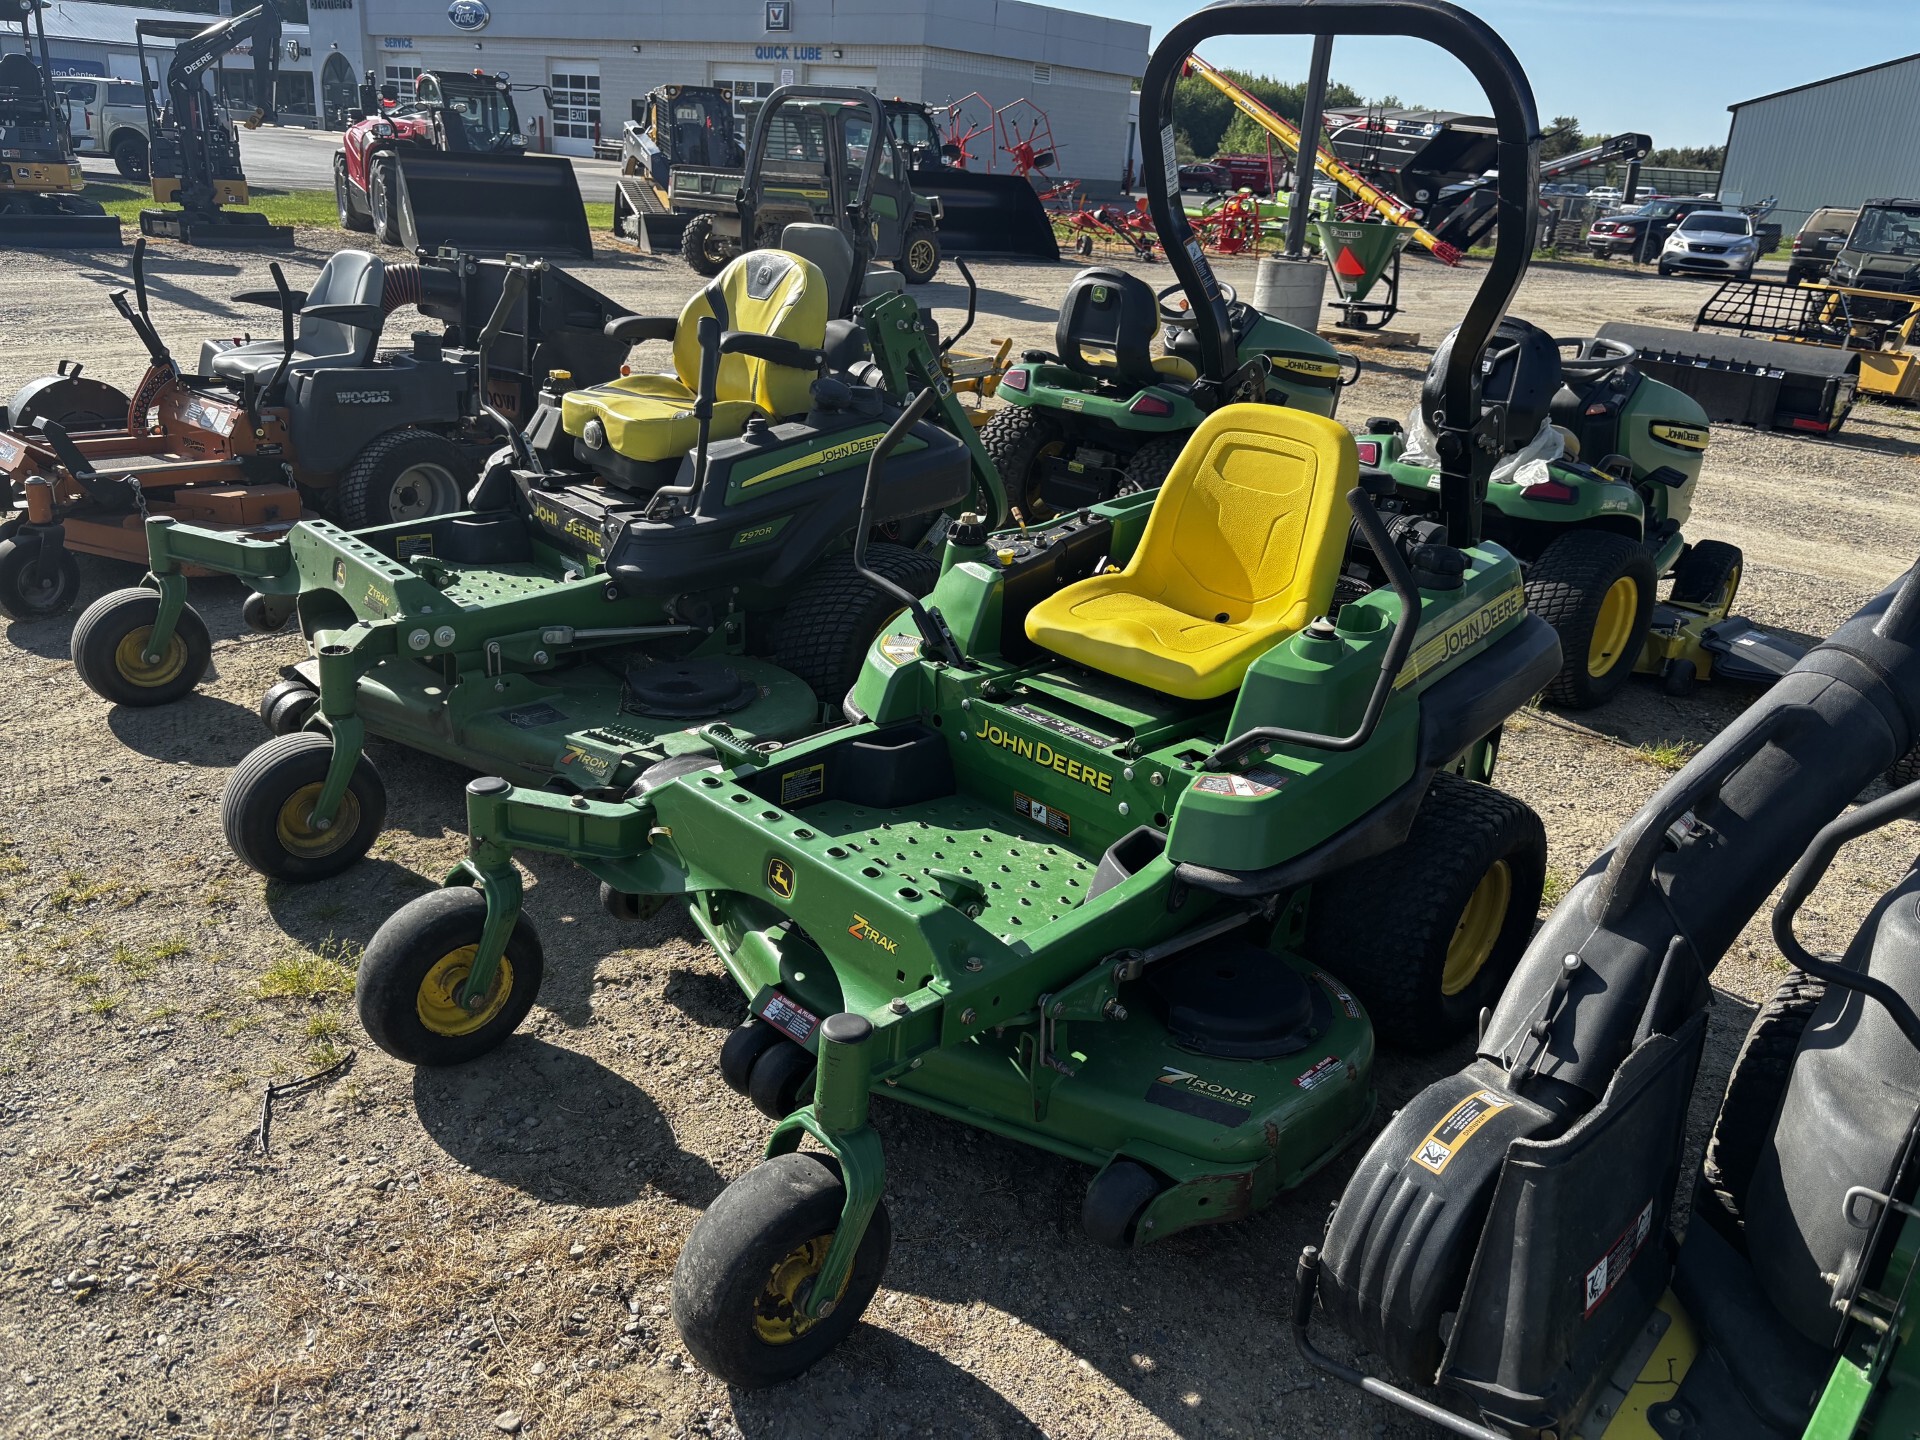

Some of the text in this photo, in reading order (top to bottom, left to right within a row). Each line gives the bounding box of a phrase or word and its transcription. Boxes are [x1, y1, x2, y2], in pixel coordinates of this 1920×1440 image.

[454, 5, 476, 24] Ford
[384, 37, 413, 49] SERVICE
[755, 46, 822, 61] QUICK LUBE
[184, 52, 213, 75] DEERE
[571, 110, 587, 121] EXIT
[1331, 227, 1362, 238] FRONTIER
[1285, 360, 1322, 372] JOHN DEERE
[336, 390, 390, 404] WOODS
[1665, 428, 1700, 442] JOHN DEERE
[820, 444, 849, 464] JOHN
[564, 518, 602, 547] DEERE
[740, 527, 772, 543] Z970R
[367, 584, 390, 607] ZTRAK
[1441, 594, 1518, 660] JOHN DEERE
[976, 719, 1034, 760] JOHN
[1035, 741, 1113, 795] DEERE
[849, 913, 898, 955] ZTRAK
[1187, 1086, 1235, 1103] Commercial
